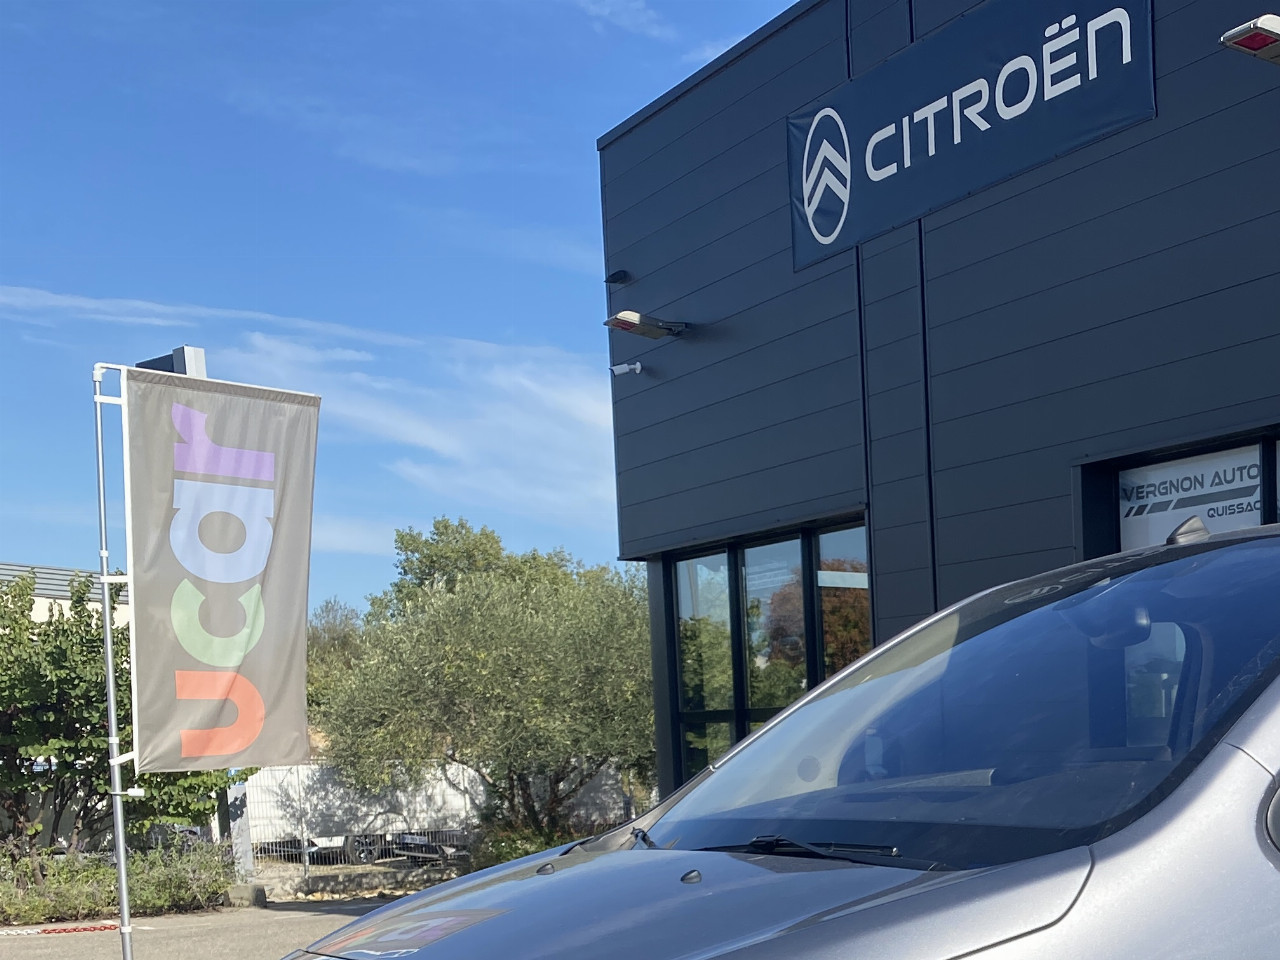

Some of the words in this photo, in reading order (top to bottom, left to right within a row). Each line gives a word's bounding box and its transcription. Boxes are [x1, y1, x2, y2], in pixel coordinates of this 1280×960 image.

[1122, 473, 1205, 502] VERGNON
[1209, 463, 1260, 488] AUTO
[1206, 500, 1260, 518] QUISSAC
[169, 402, 275, 758] ucar
